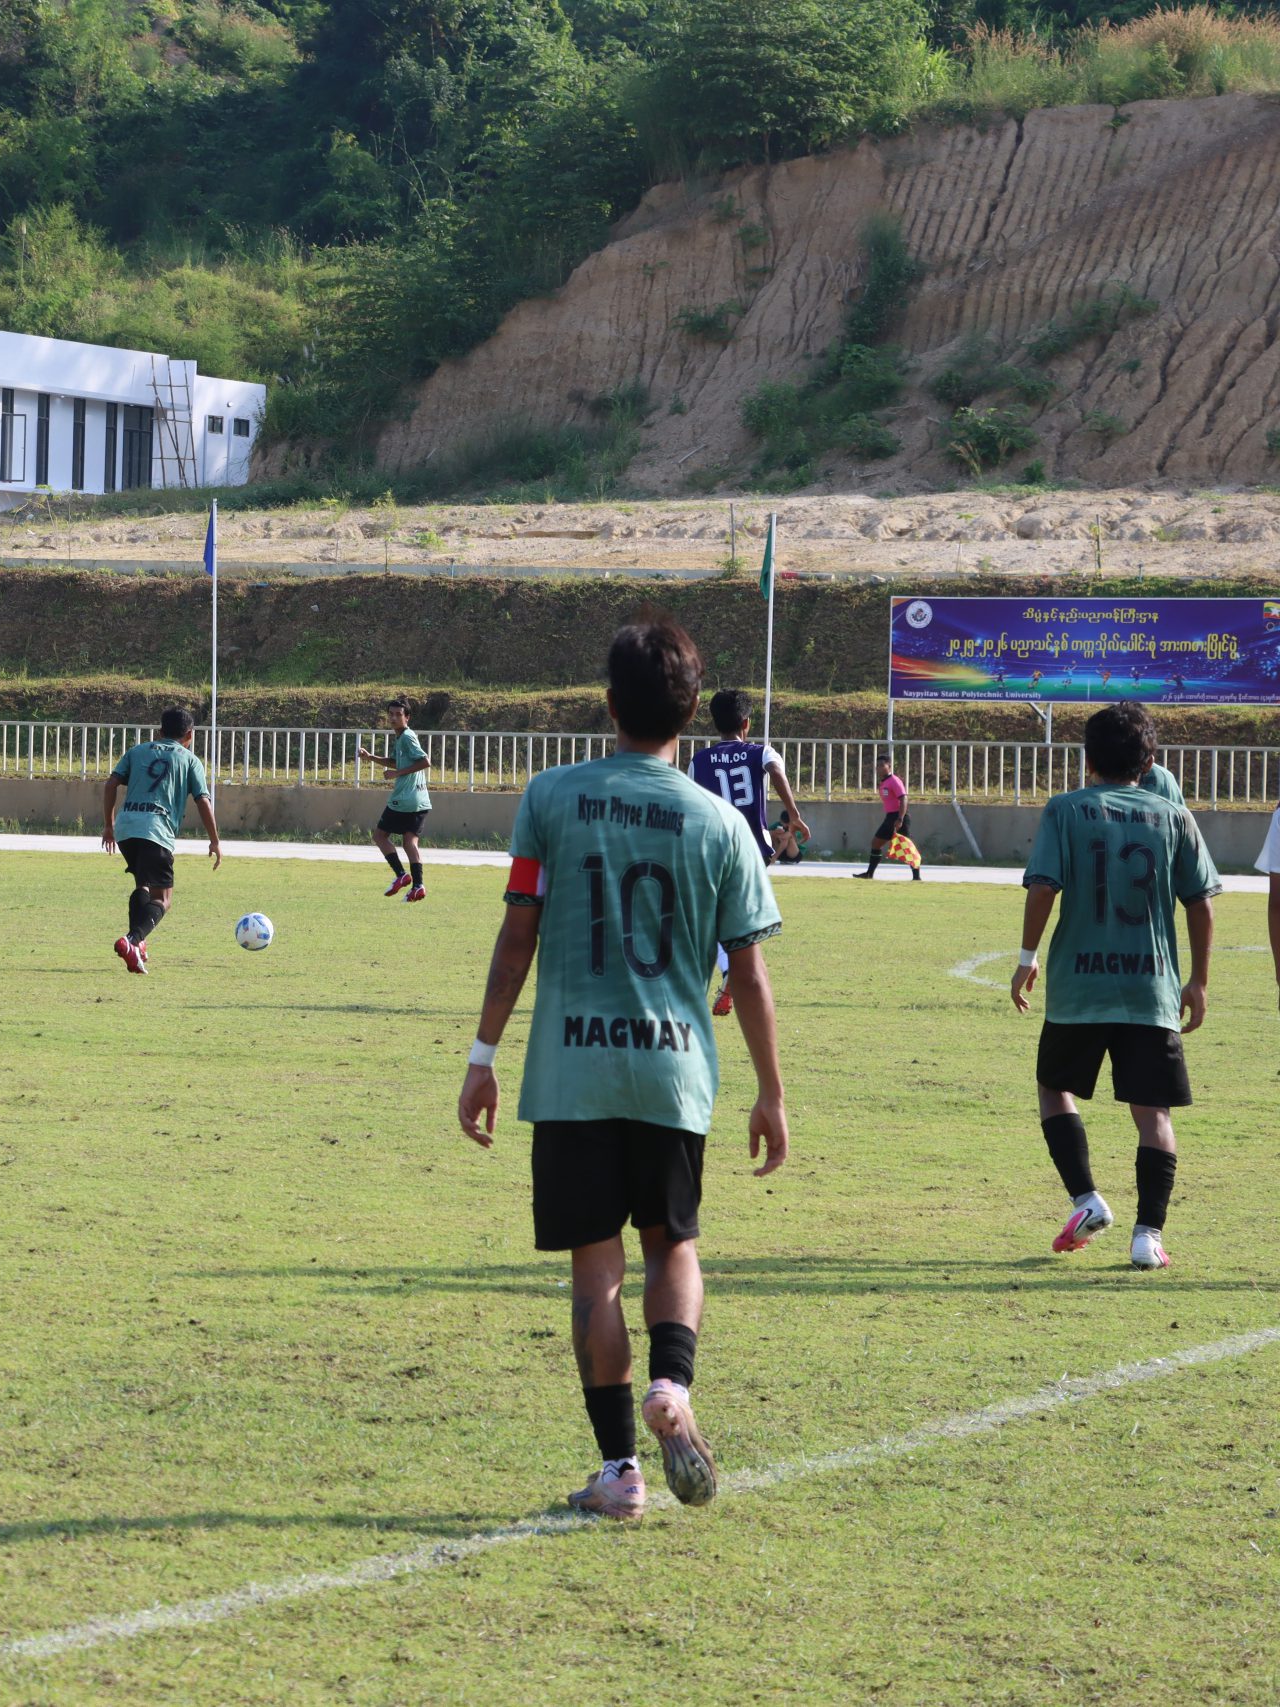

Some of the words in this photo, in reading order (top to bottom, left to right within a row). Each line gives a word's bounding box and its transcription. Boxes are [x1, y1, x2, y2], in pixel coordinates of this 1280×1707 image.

[903, 690, 939, 699] Naypyitaw
[940, 690, 959, 698] State
[961, 690, 1003, 699] Polytechnic
[1005, 691, 1041, 700] University
[147, 758, 170, 793] 9
[710, 751, 748, 764] H.M.OO
[714, 765, 754, 807] 13
[578, 794, 607, 826] Kyaw
[645, 802, 685, 837] Khaing
[1080, 804, 1097, 820] Ye
[1088, 837, 1157, 926] 13
[577, 852, 677, 982] 10
[563, 1016, 691, 1052] MAGWAY
